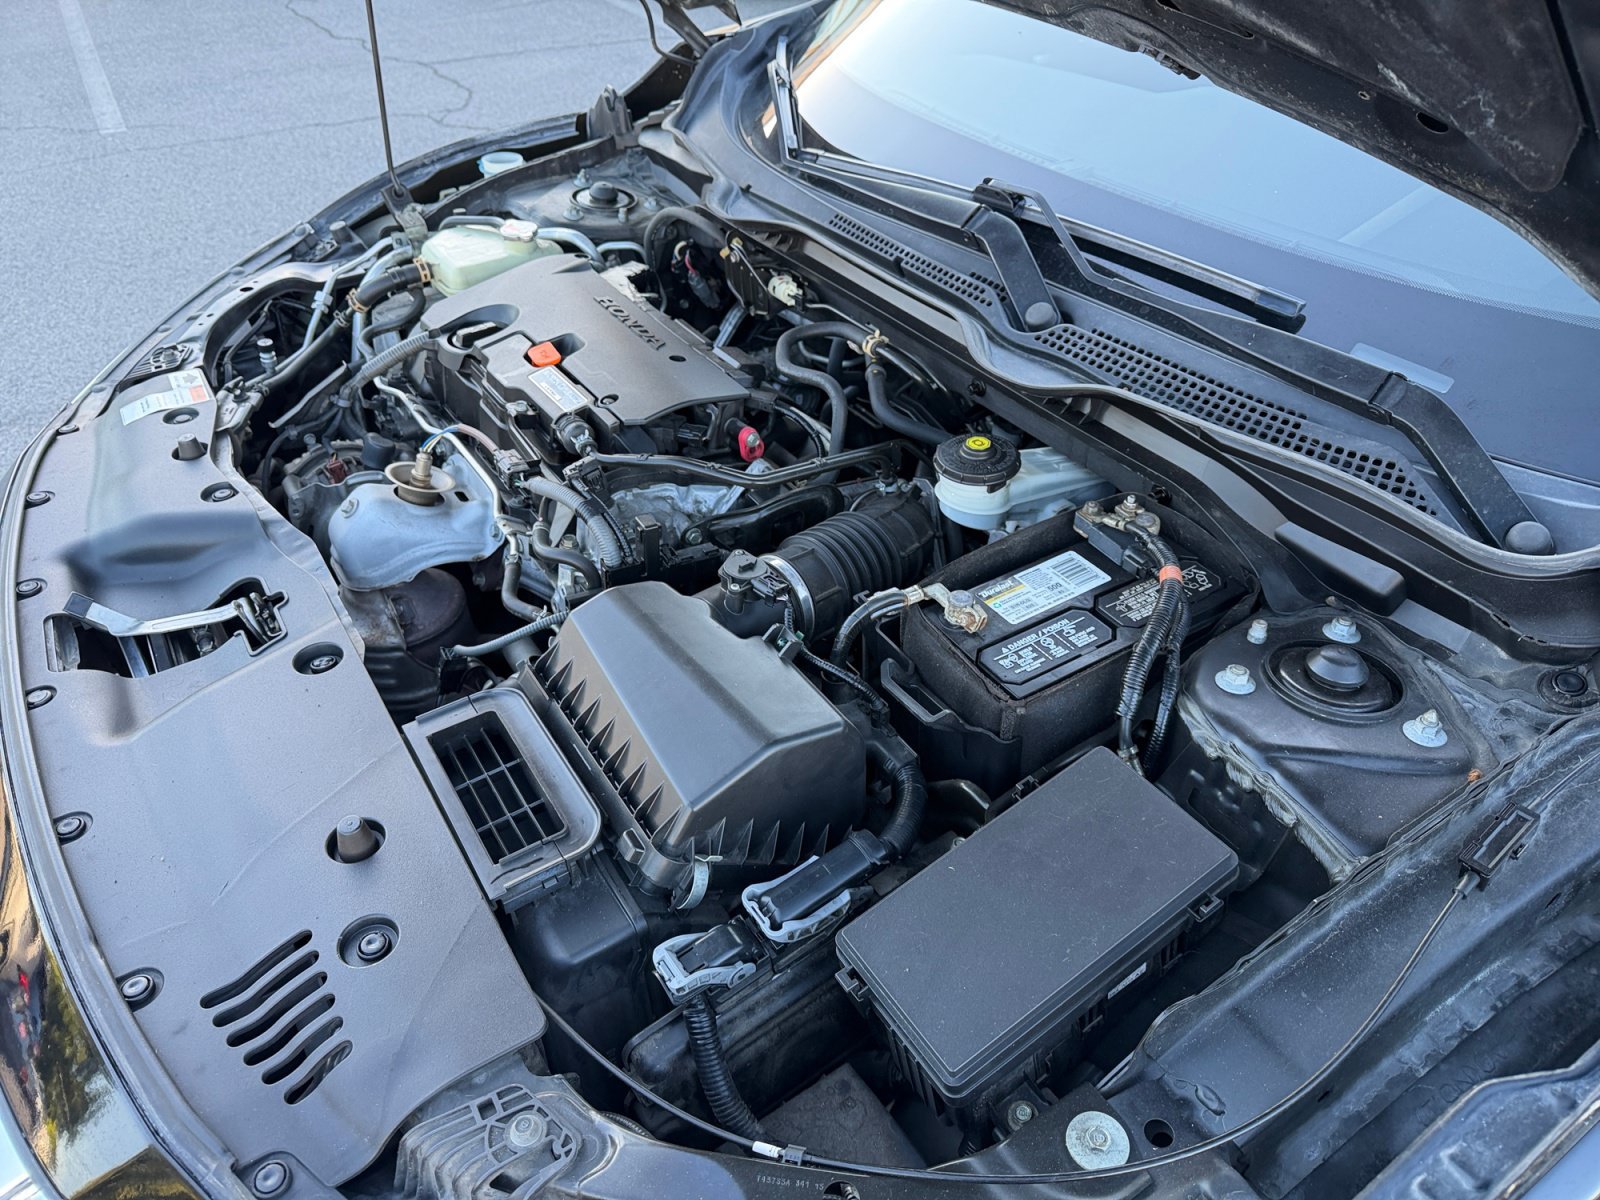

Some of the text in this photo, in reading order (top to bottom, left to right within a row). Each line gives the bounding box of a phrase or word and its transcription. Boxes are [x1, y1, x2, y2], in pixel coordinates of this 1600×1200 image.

[593, 296, 667, 351] HONDA
[1007, 633, 1039, 651] DANGER
[1042, 618, 1071, 635] POISON
